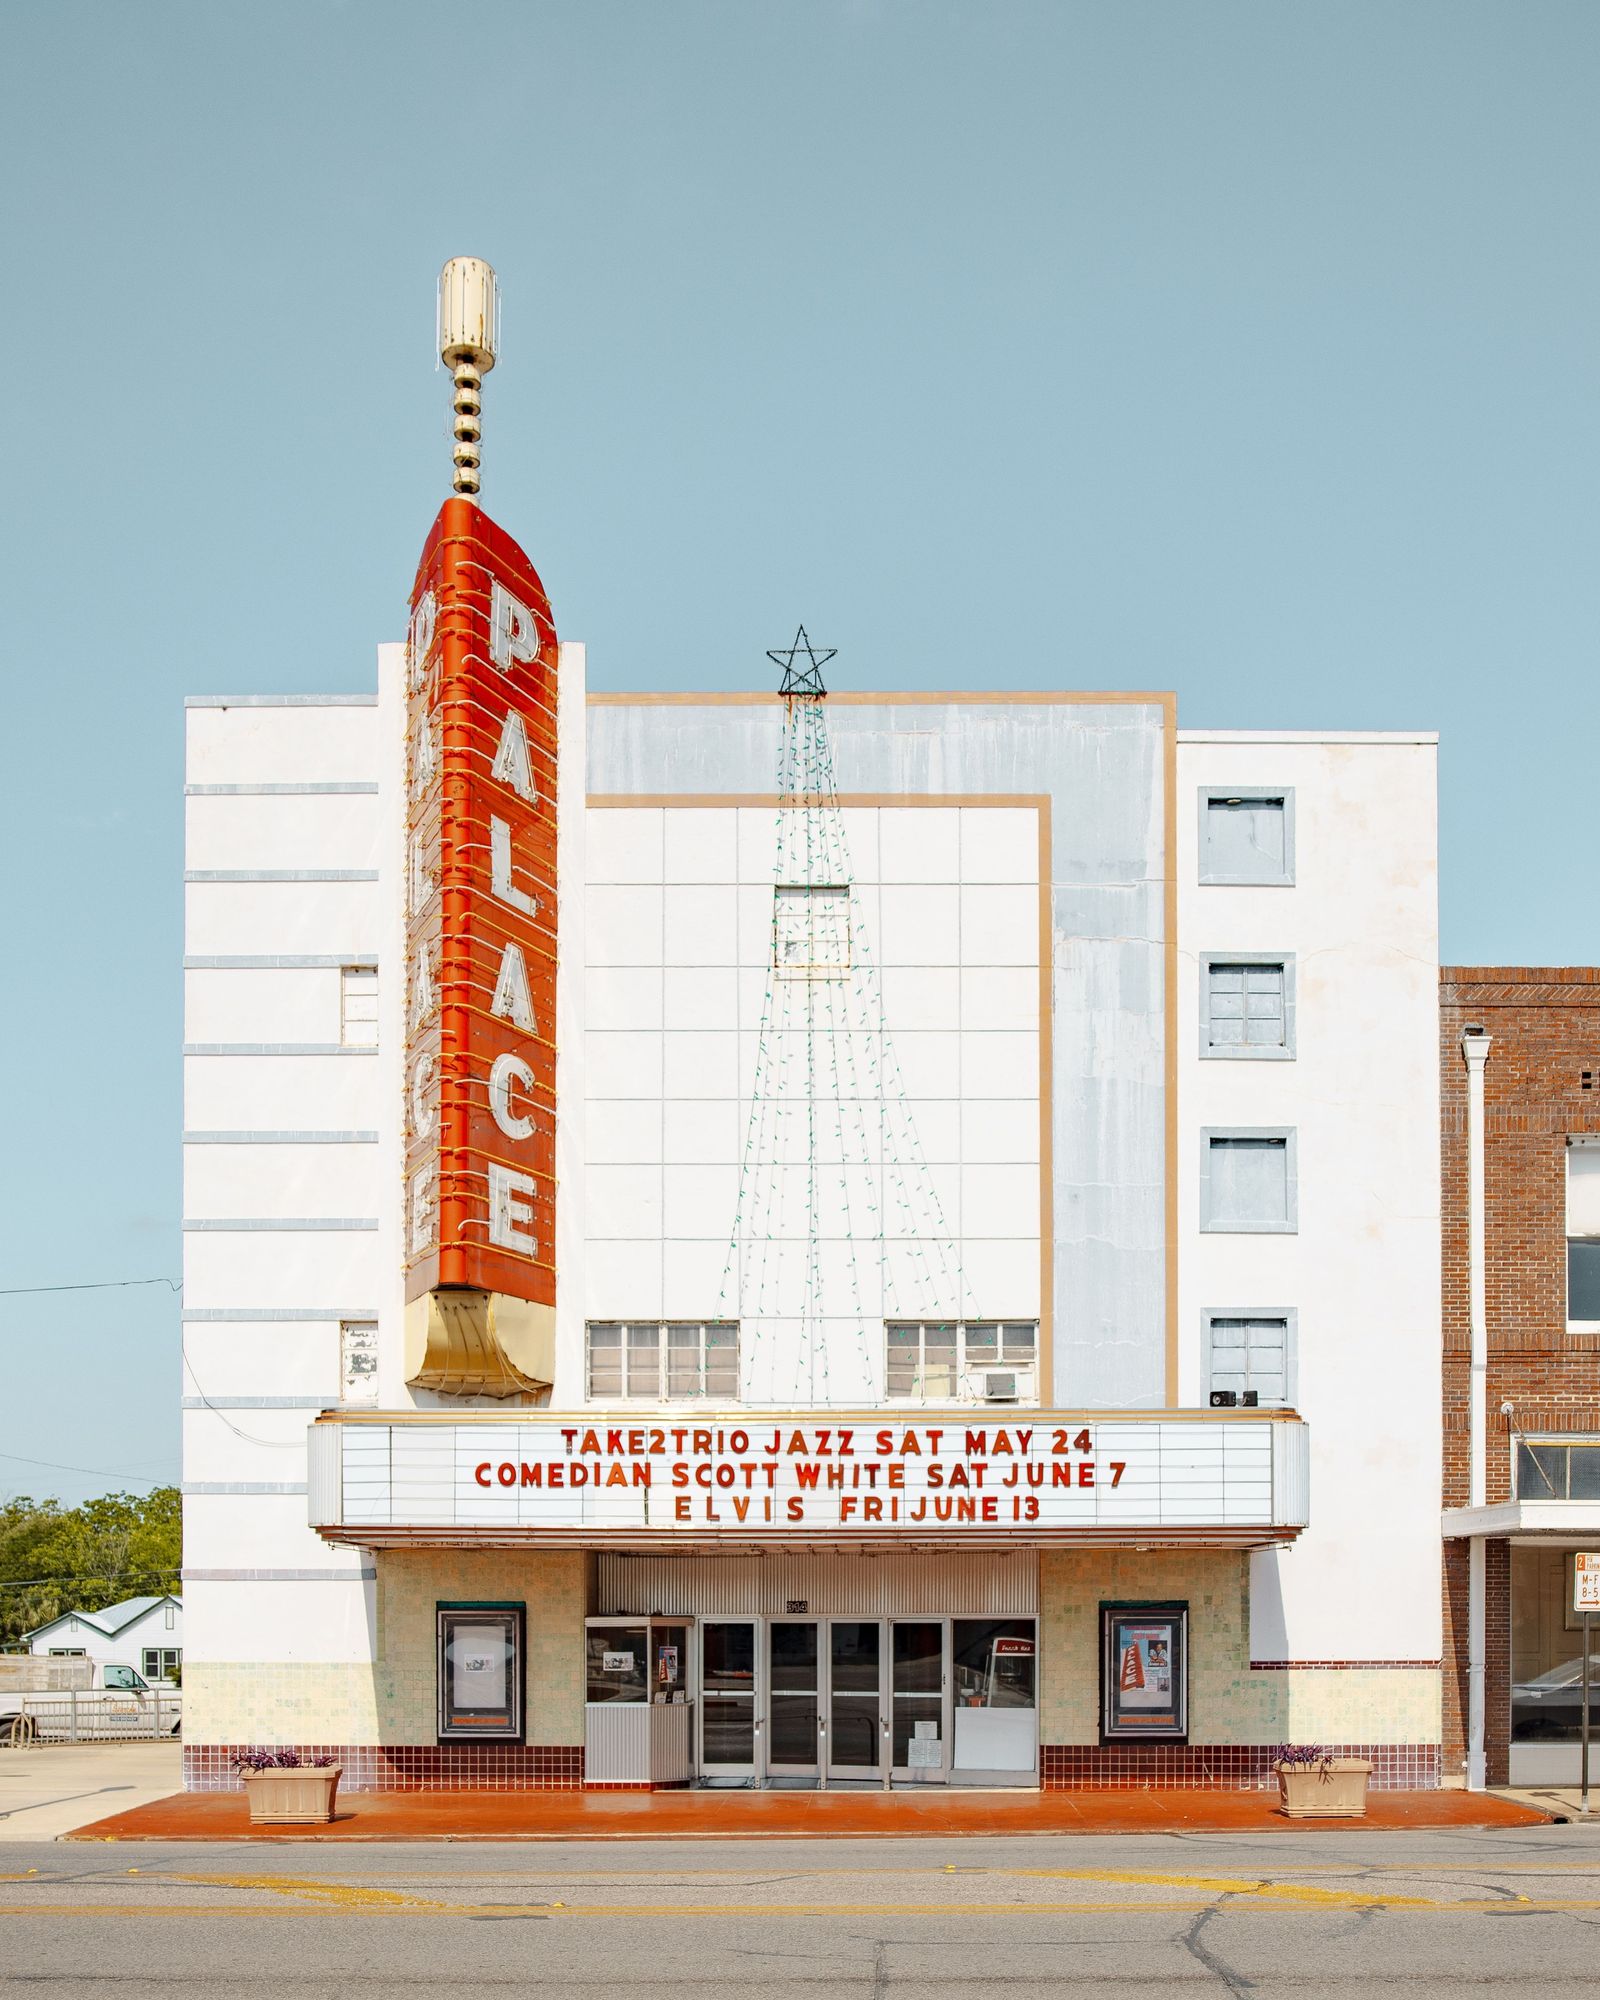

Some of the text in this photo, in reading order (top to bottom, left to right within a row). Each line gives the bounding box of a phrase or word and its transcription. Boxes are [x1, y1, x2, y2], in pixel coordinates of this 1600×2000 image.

[487, 575, 541, 1259] PALACE
[764, 1429, 854, 1456] JAZZ
[876, 1429, 943, 1456] SAT
[965, 1429, 1033, 1456] MAY
[1051, 1429, 1092, 1455] 24
[475, 1462, 1126, 1489] COMEDIAN SCOTT WHITE SAT JUNE 7
[675, 1495, 1040, 1522] ELVIS FRI JUNE 13
[1582, 1587, 1599, 1598] 8-5
